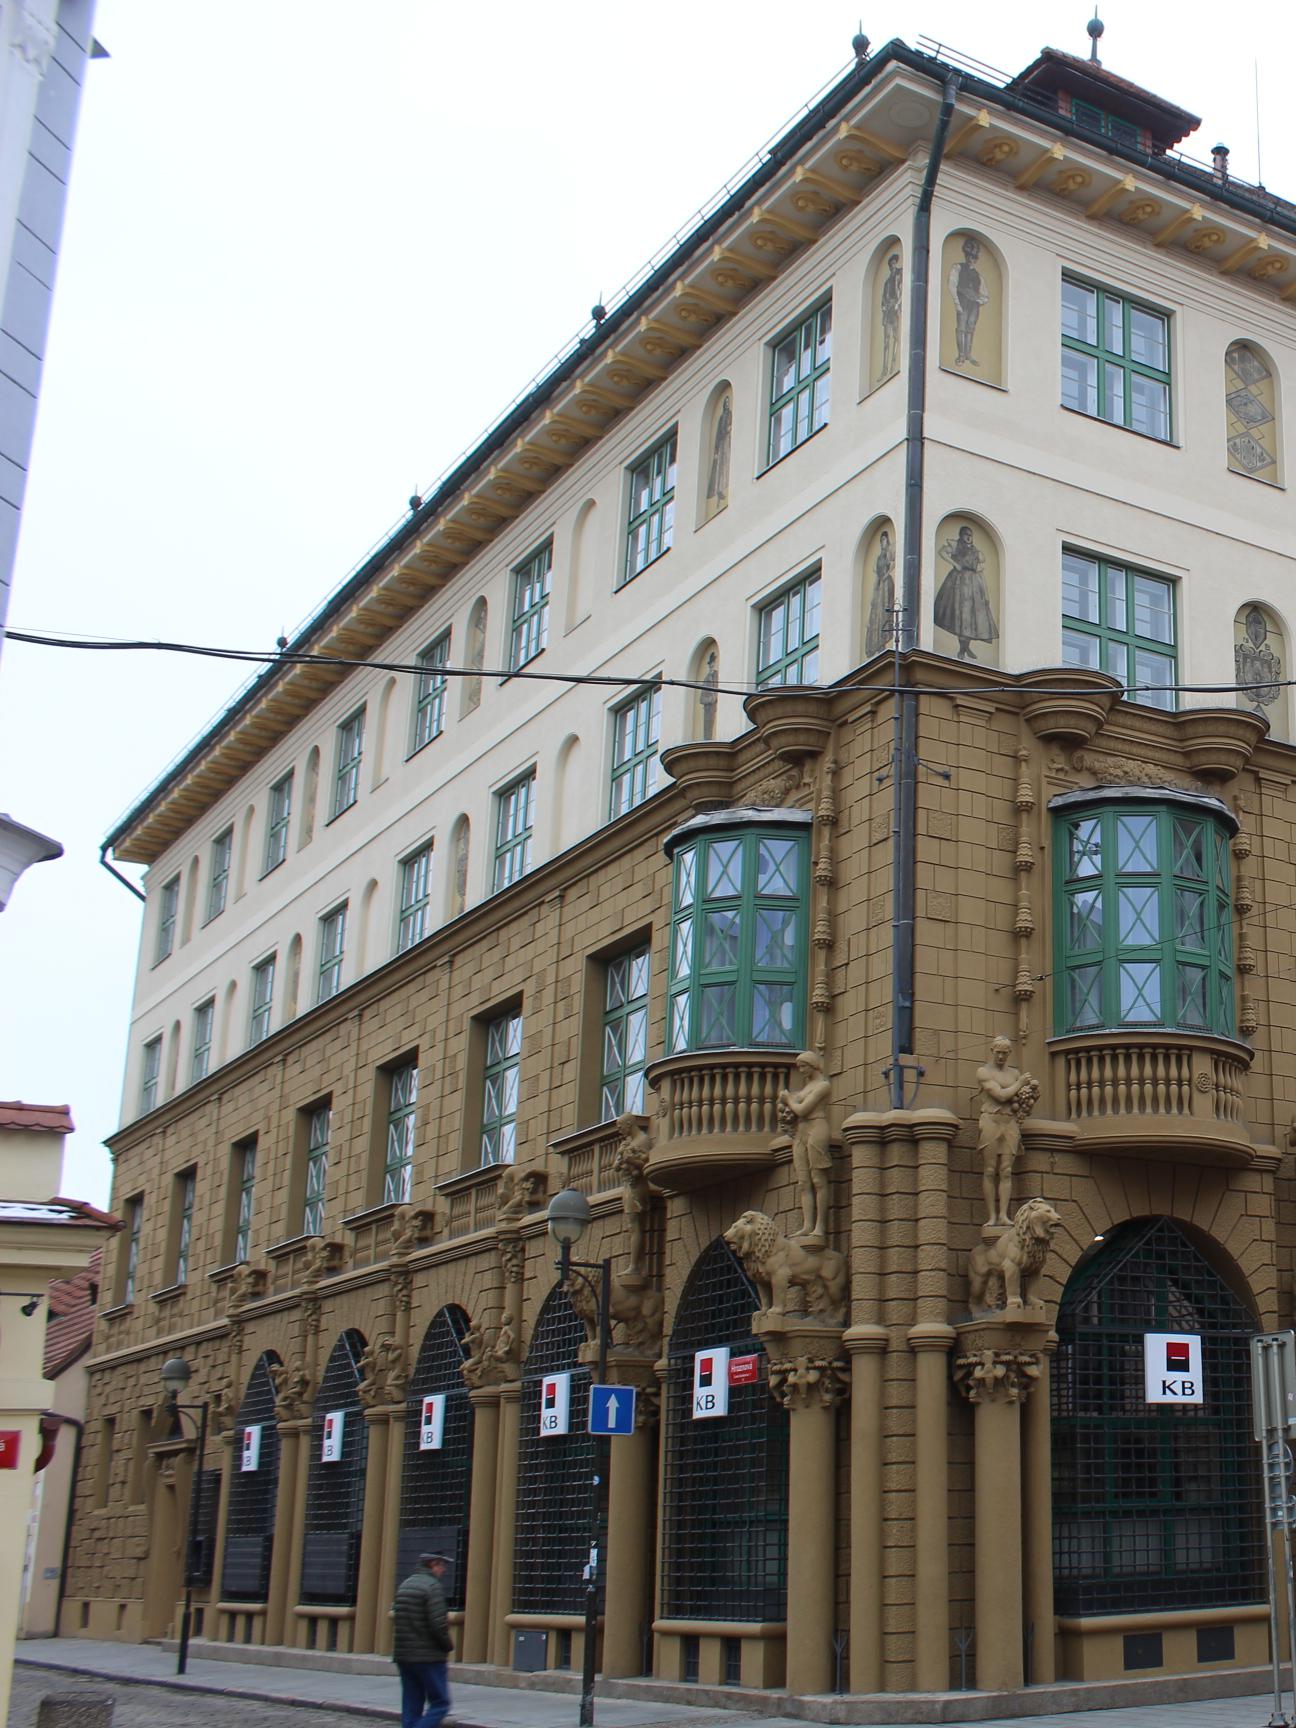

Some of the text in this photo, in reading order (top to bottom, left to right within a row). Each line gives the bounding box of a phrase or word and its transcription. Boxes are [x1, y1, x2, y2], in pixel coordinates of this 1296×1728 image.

[1161, 1379, 1195, 1396] KB
[696, 1394, 715, 1412] KB
[542, 1415, 558, 1430] KB
